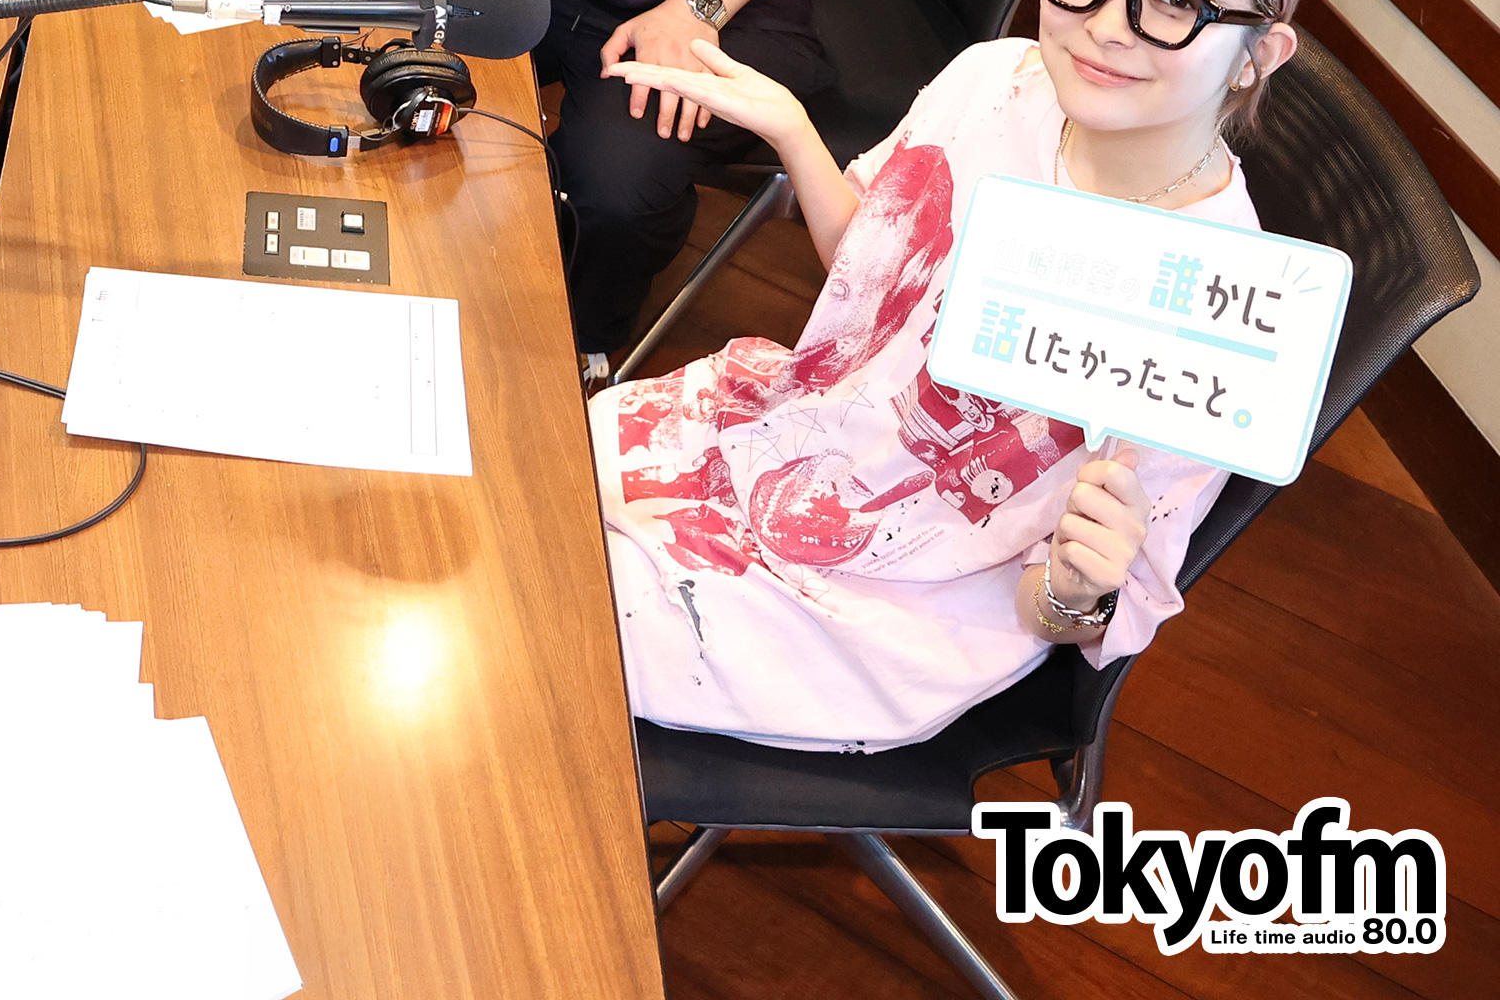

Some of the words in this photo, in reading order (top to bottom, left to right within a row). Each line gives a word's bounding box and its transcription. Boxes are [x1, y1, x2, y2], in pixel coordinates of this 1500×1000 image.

[972, 299, 1252, 430] 話したかったこと。
